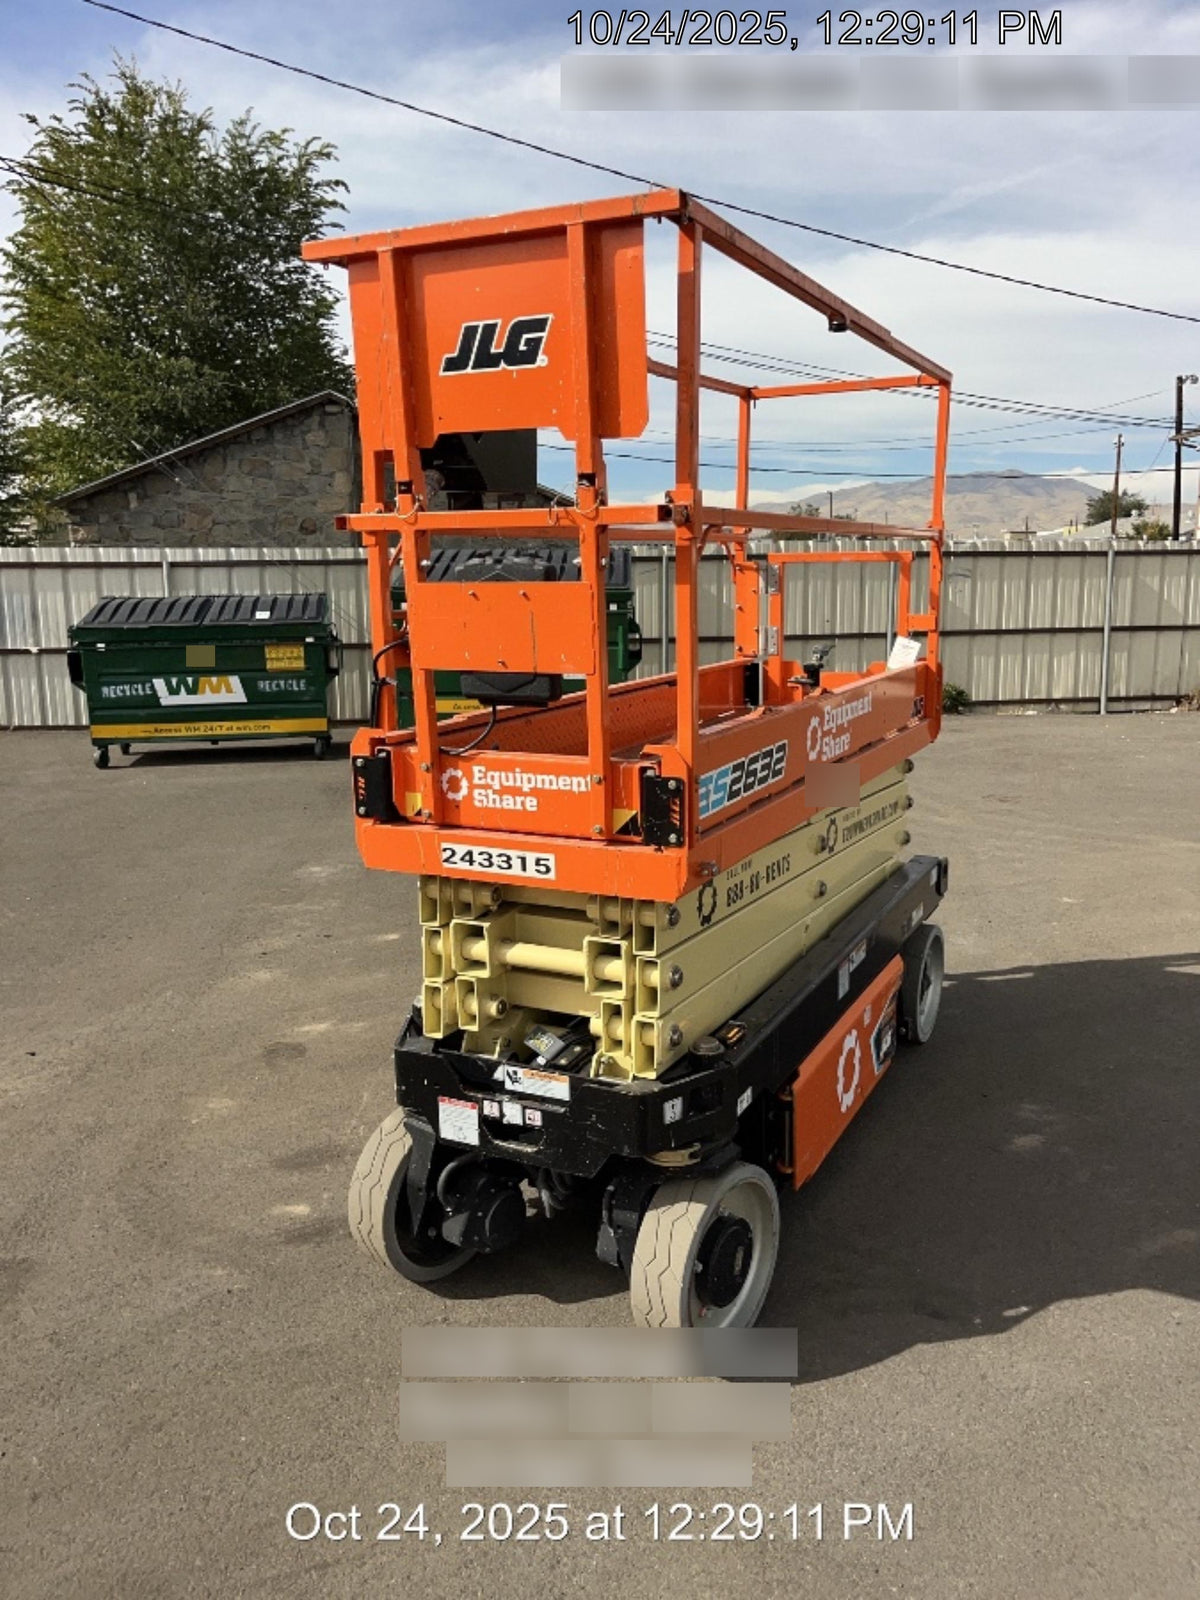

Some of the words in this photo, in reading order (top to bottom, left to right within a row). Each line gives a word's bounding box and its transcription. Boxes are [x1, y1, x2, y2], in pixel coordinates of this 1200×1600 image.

[439, 314, 554, 376] JLG
[102, 682, 153, 698] RECYCLE
[163, 675, 235, 696] WM
[257, 679, 307, 693] RECYCLE
[822, 690, 873, 733] Equipment
[821, 732, 851, 762] Share
[699, 739, 788, 819] ES2632
[472, 788, 538, 812] Share
[441, 847, 553, 875] 243315
